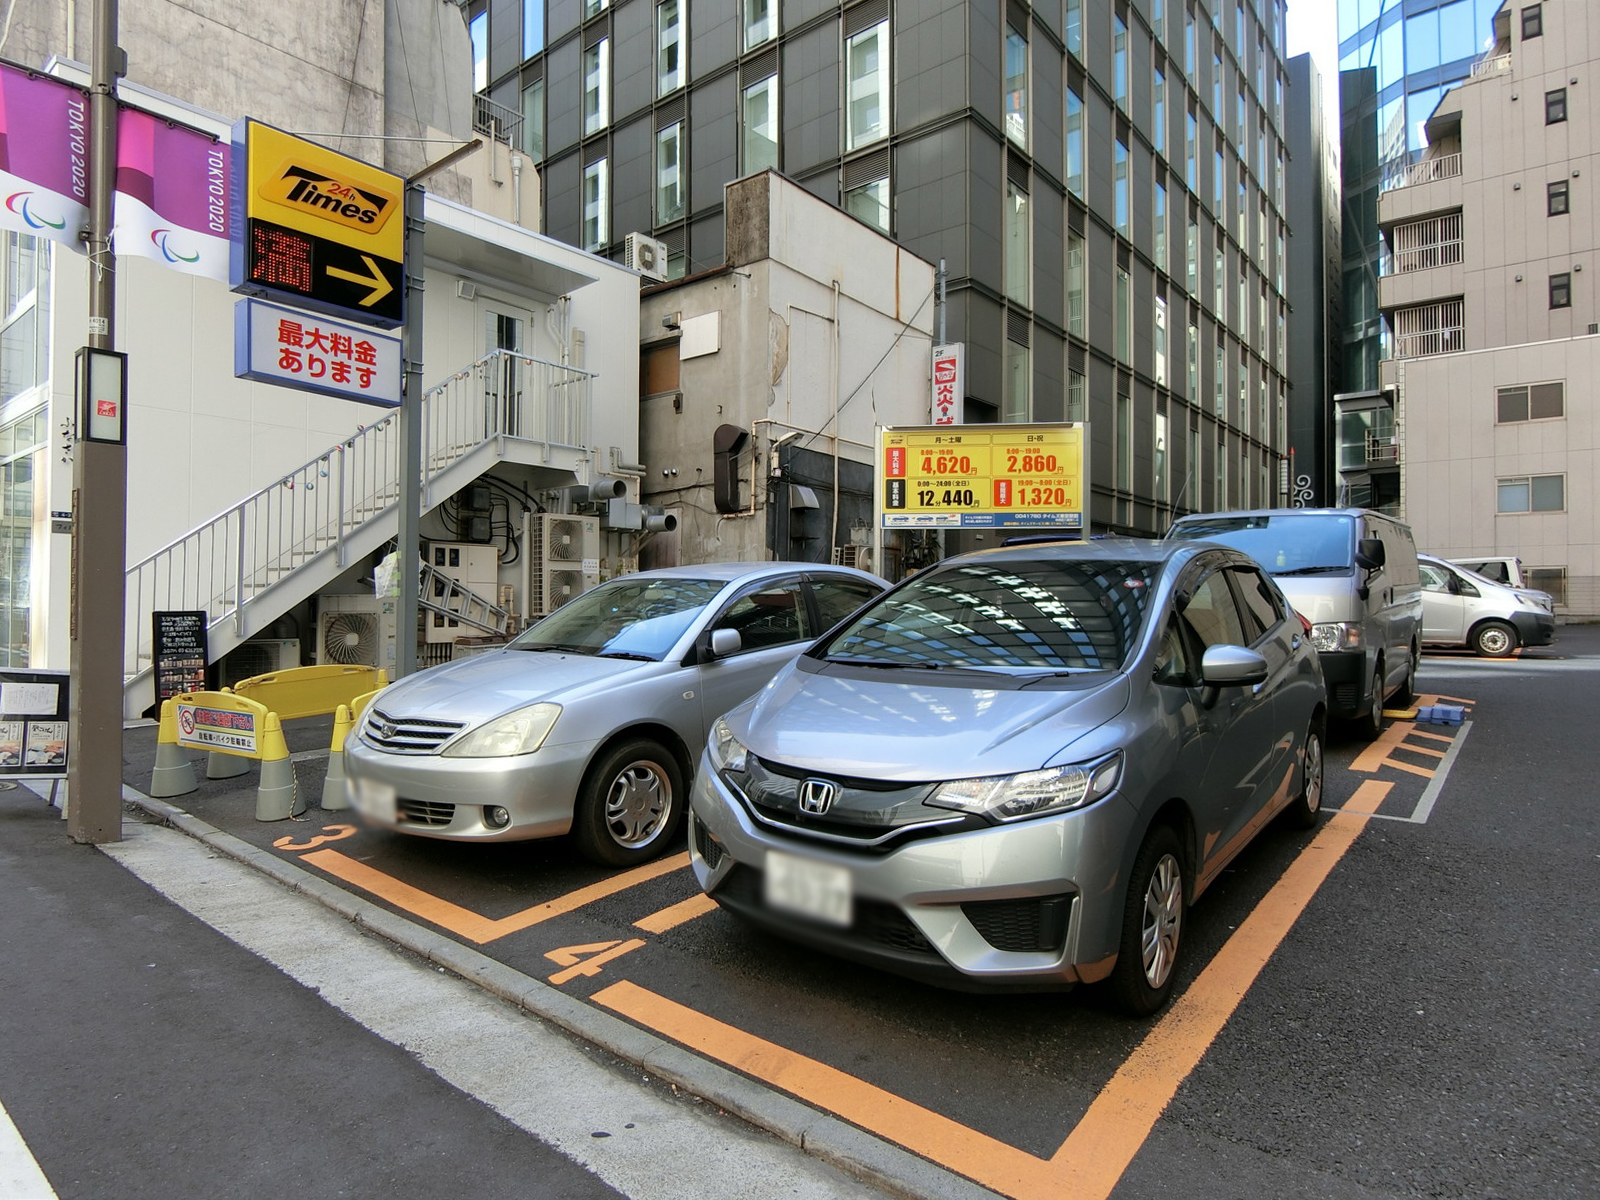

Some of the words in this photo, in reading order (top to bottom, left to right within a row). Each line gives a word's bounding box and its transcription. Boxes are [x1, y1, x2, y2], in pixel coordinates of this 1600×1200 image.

[68, 100, 85, 155] TOKYO
[71, 154, 86, 197] 2020
[208, 150, 224, 195] TOKYO
[327, 183, 356, 201] 24h
[209, 196, 225, 232] 2020
[281, 165, 381, 224] Times
[278, 319, 377, 366] 最大料金
[934, 349, 944, 357] 2F
[278, 347, 377, 389] あります
[272, 824, 358, 852] 3
[543, 938, 647, 985] 4
